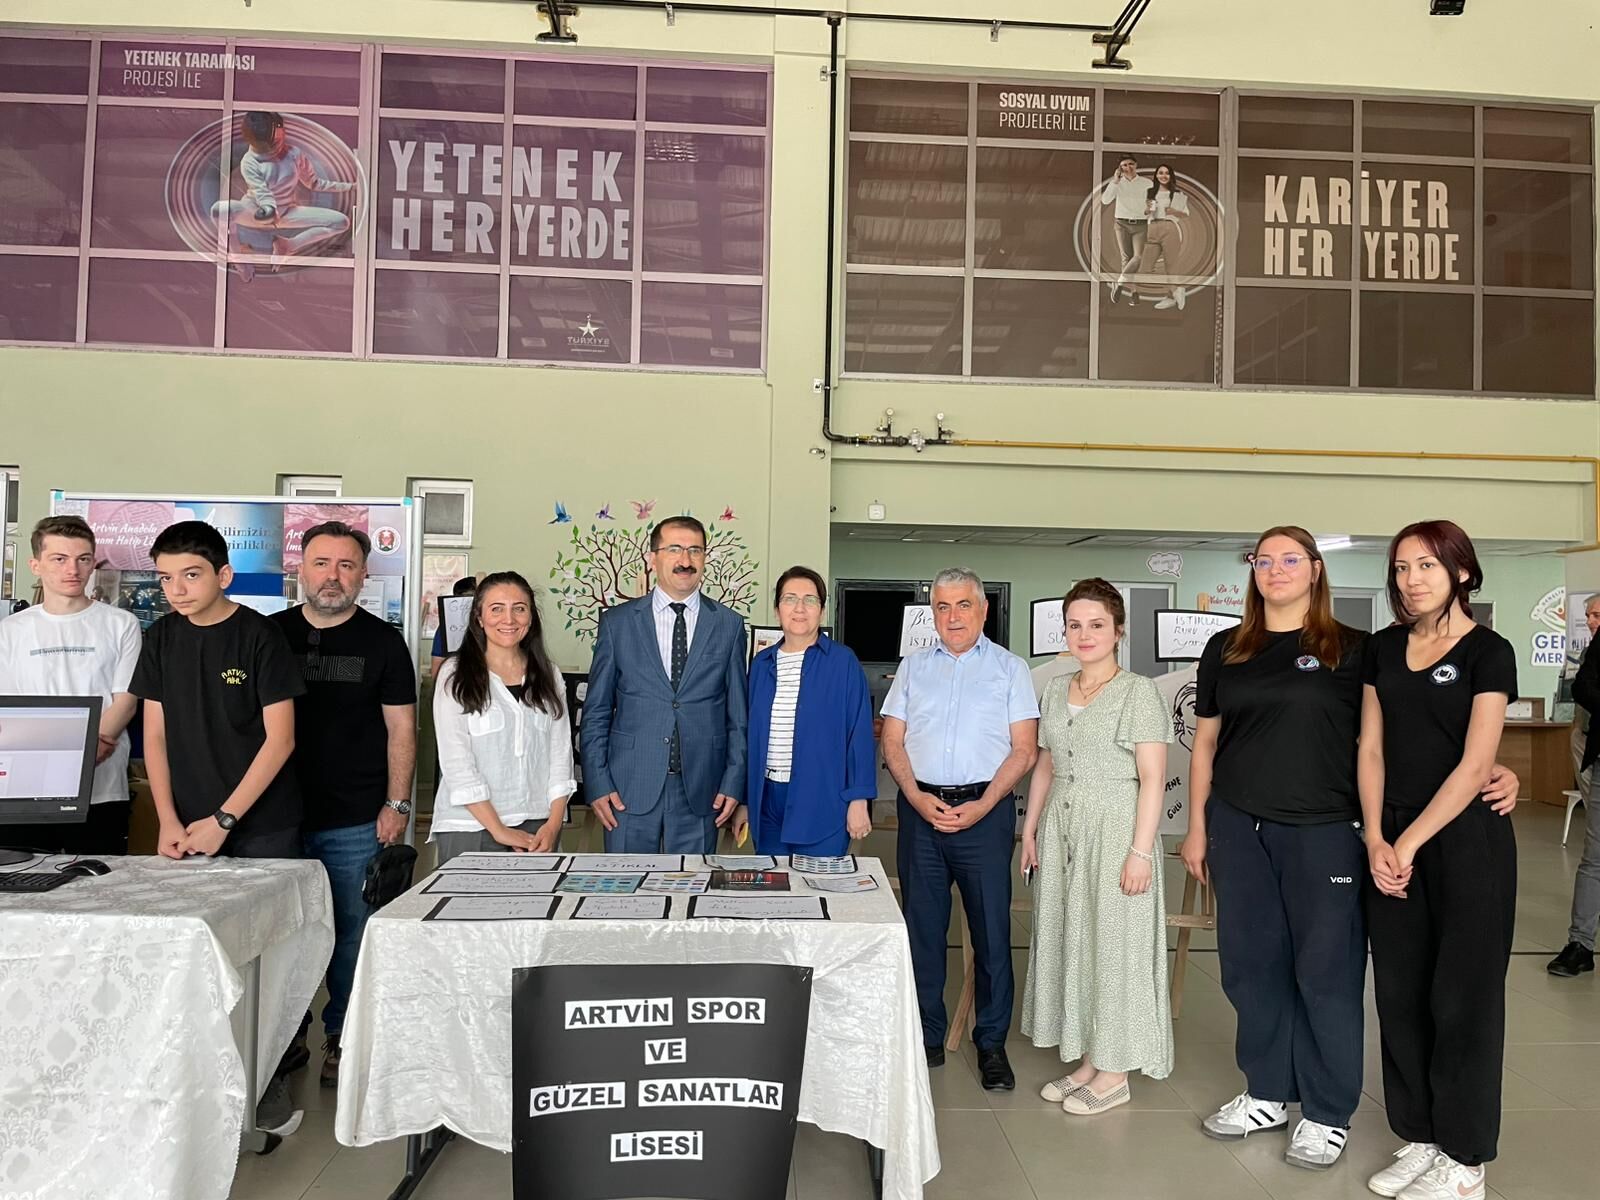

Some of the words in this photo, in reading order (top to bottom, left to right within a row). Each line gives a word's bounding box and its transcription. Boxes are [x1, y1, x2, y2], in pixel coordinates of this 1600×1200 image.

[124, 49, 181, 67] YETENEK
[184, 51, 255, 71] TARAMASI
[123, 69, 178, 87] PROJESİ
[182, 70, 201, 88] İLE
[999, 92, 1047, 109] SOSYAL
[1050, 94, 1090, 111] UYUM
[999, 112, 1065, 130] PROJELERİ
[1069, 112, 1087, 131] İLE
[388, 139, 622, 202] YETENEK
[1264, 170, 1449, 228] KARİYER
[391, 197, 495, 254] HER
[512, 203, 630, 260] YERDE
[1264, 227, 1334, 277] HER
[1364, 231, 1459, 281] YERDE
[119, 522, 158, 534] Anadolu
[1535, 652, 1563, 664] MER
[1330, 876, 1352, 884] VOID
[568, 999, 670, 1026] ARTVİN
[690, 1001, 761, 1021] SPOR
[647, 1041, 683, 1061] VE
[533, 1085, 622, 1112] GÜZEL
[643, 1082, 779, 1106] SANATLAR
[615, 1131, 699, 1158] LİSESİ
